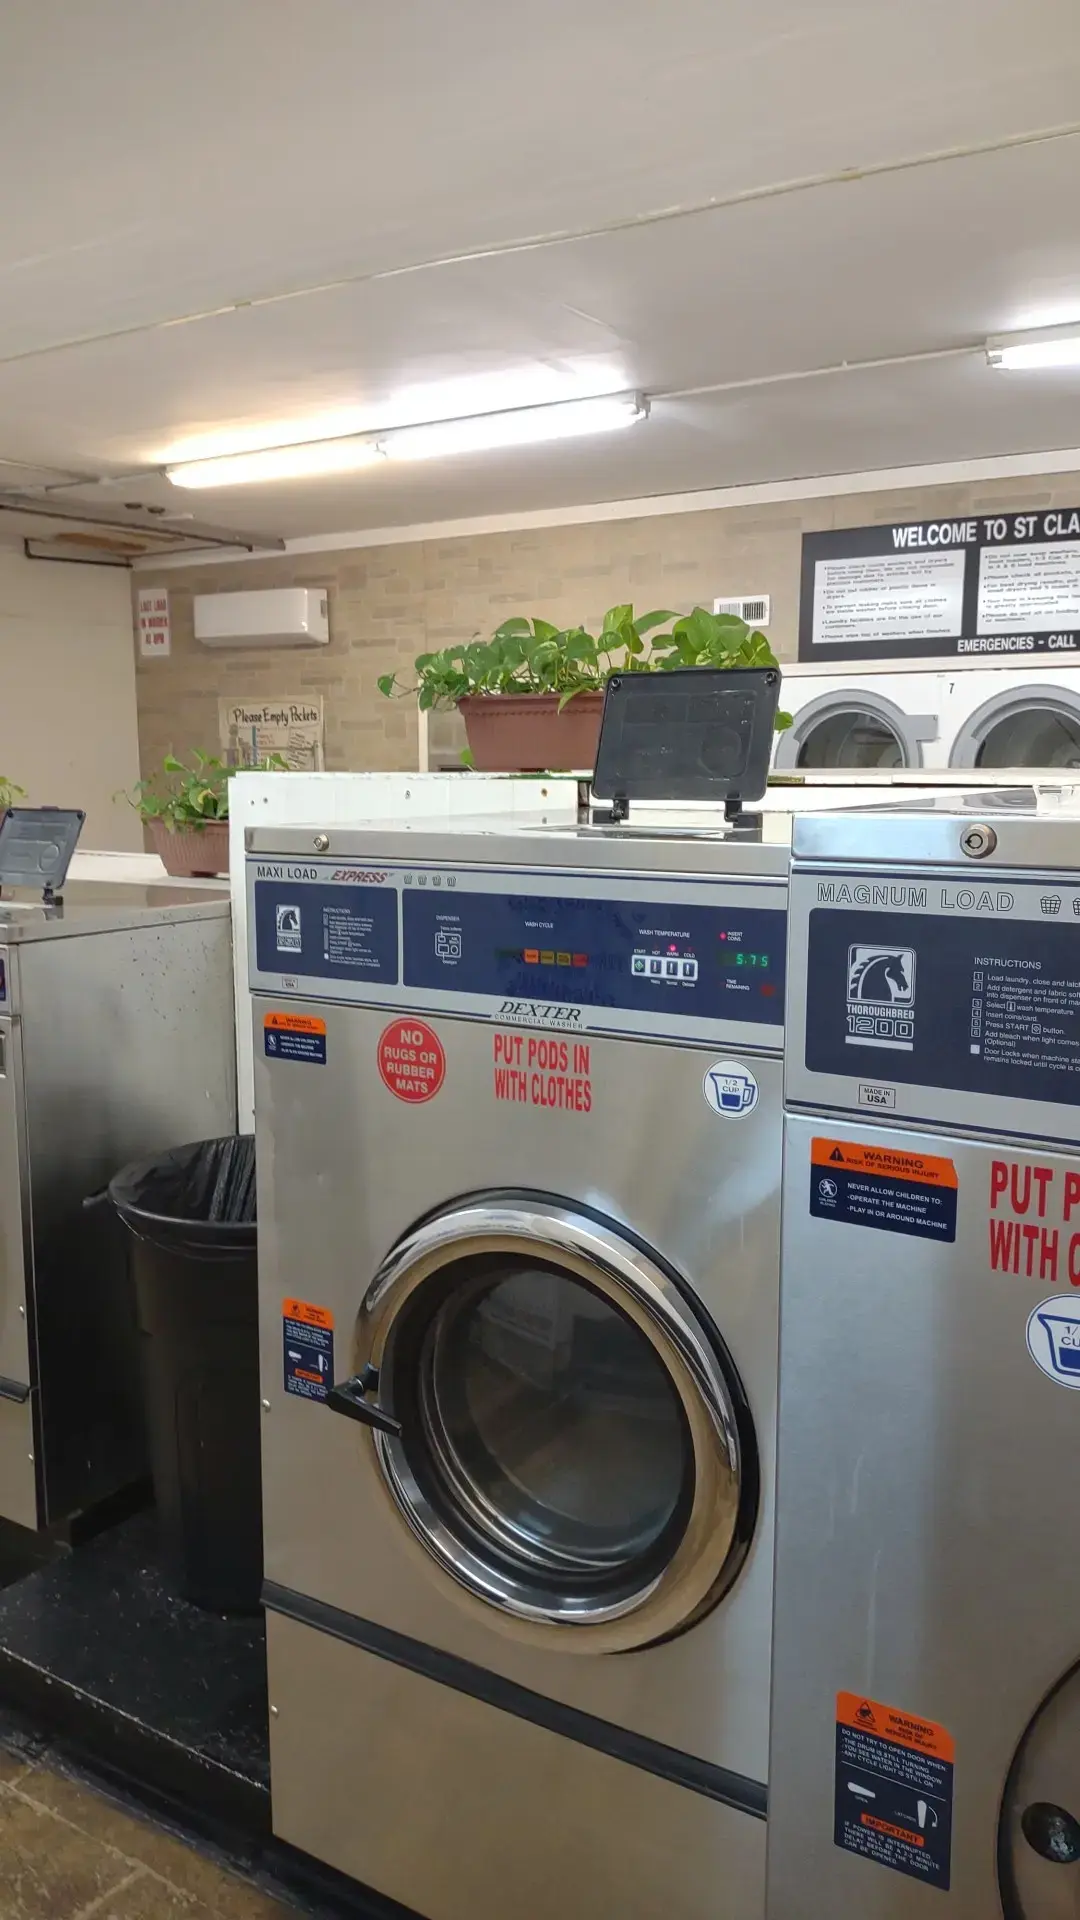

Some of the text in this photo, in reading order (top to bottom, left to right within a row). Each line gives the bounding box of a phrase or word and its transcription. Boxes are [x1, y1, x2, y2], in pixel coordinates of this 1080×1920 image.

[893, 522, 976, 548] WELCOME
[983, 519, 1007, 540] TO
[1014, 516, 1037, 538] ST
[958, 635, 1076, 652] EMERGENCIES CALL
[949, 683, 954, 694] 7
[233, 705, 317, 726] Please Empty Pockets
[258, 866, 283, 878] MAXI
[287, 868, 317, 879] LOAD
[331, 870, 389, 883] EXPRESS
[817, 883, 1015, 911] MAGNUM LOAD
[654, 930, 690, 938] TEMPERATURE
[974, 957, 1041, 970] INSTRUCTIONS
[1000, 993, 1031, 1002] dispenser
[1002, 986, 1032, 994] detergent
[499, 1001, 582, 1021] DEXTER
[846, 1004, 914, 1019] THOROUGHBRED
[986, 1001, 1005, 1009] Select
[1035, 1006, 1075, 1015] temperature.
[494, 1014, 583, 1029] COMMERCIAL WASHER
[846, 1015, 913, 1039] 1200
[985, 1020, 1003, 1028] Press
[401, 1030, 423, 1045] NO
[984, 1038, 1016, 1047] (Optional)
[999, 1032, 1020, 1040] bleach
[1042, 1035, 1055, 1044] light
[384, 1046, 437, 1064] RUGS OR
[494, 1034, 590, 1075] PUT PODS IN
[1022, 1052, 1040, 1060] when
[1041, 1054, 1069, 1062] machine
[386, 1064, 435, 1079] RUBBER
[1011, 1058, 1032, 1066] locked
[1034, 1060, 1047, 1068] until
[1049, 1062, 1066, 1070] cycle
[396, 1079, 428, 1094] MATS
[494, 1068, 591, 1112] WITH CLOTHES
[867, 1095, 887, 1104] USA
[846, 1157, 862, 1166] RISK
[878, 1162, 910, 1174] SERIOUS
[912, 1168, 940, 1179] INJURY
[863, 1151, 924, 1169] WARNING
[848, 1182, 869, 1191] NEVER
[870, 1185, 894, 1196] ALLOW
[896, 1191, 930, 1203] CHILDREN
[990, 1160, 1053, 1217] PUT
[882, 1199, 894, 1207] THE
[896, 1202, 926, 1214] MACHINE
[875, 1210, 885, 1218] OR
[886, 1212, 915, 1223] AROUND
[916, 1217, 947, 1229] MACHINE
[990, 1218, 1059, 1282] WITH
[889, 1714, 935, 1736] WARNING
[842, 1728, 850, 1736] DO
[852, 1732, 864, 1741] NOT
[866, 1737, 878, 1745] TRY
[879, 1741, 887, 1749] TO
[889, 1746, 906, 1756] OPEN
[907, 1753, 926, 1764] DOOR
[857, 1742, 875, 1752] DRUM
[884, 1752, 900, 1762] STILL
[902, 1758, 929, 1774] TURNING
[857, 1756, 878, 1767] CYCLE
[879, 1763, 897, 1774] LIGHT
[906, 1773, 922, 1783] STILL
[924, 1780, 934, 1788] ON
[859, 1750, 870, 1758] SEE
[871, 1754, 893, 1767] WATER
[902, 1765, 914, 1774] THE
[915, 1770, 942, 1784] WINDOW
[853, 1824, 875, 1837] POWER
[865, 1816, 917, 1843] IMPORTANT
[844, 1840, 857, 1848] CAN
[844, 1827, 864, 1838] THERE
[867, 1837, 881, 1846] WILL
[916, 1855, 940, 1870] MINUTE
[844, 1833, 864, 1843] DELAY
[866, 1842, 892, 1855] BEFORE
[910, 1859, 929, 1871] DOOR
